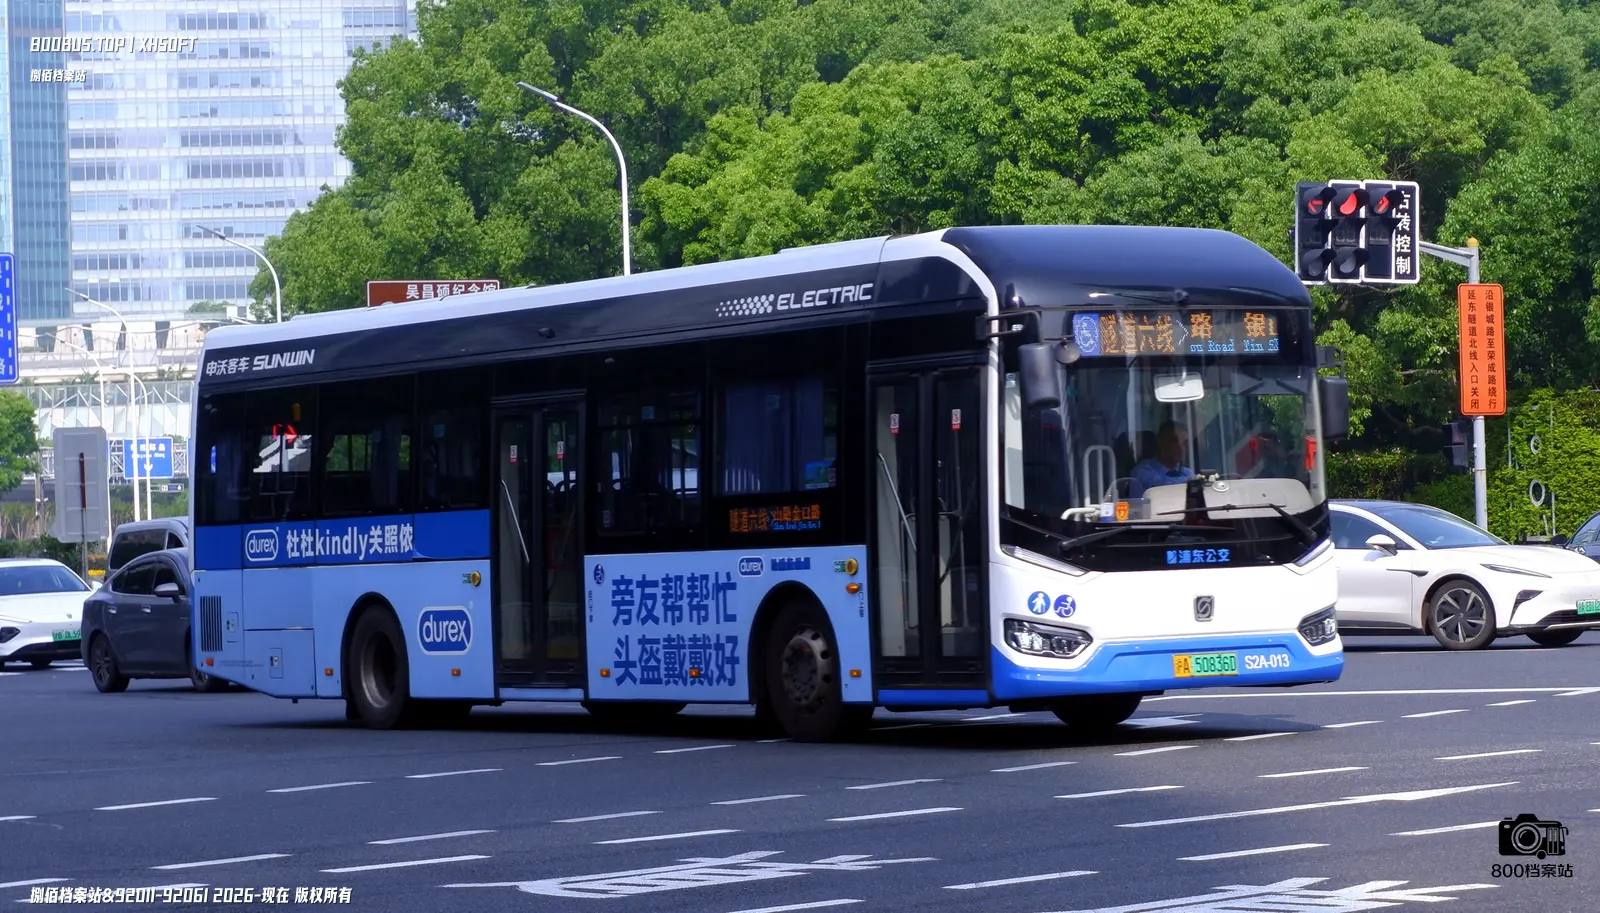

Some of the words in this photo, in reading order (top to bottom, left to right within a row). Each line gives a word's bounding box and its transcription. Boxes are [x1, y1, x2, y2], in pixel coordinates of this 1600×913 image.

[777, 283, 874, 310] ELECTRIC
[206, 357, 250, 377] 申沃客车
[252, 349, 315, 372] SUNWIN
[1467, 289, 1480, 409] 延东隧道北线入口关闭
[1485, 289, 1497, 409] 沿银城路至荣成路绕行
[249, 536, 276, 554] durex
[286, 523, 413, 560] 杜杜kindly关照侬
[1178, 548, 1231, 564] 浦东公交
[611, 571, 737, 626] 旁友帮帮忙
[422, 614, 469, 649] durex
[613, 633, 740, 687] 头盔戴戴好
[1245, 654, 1290, 670] S2A-013
